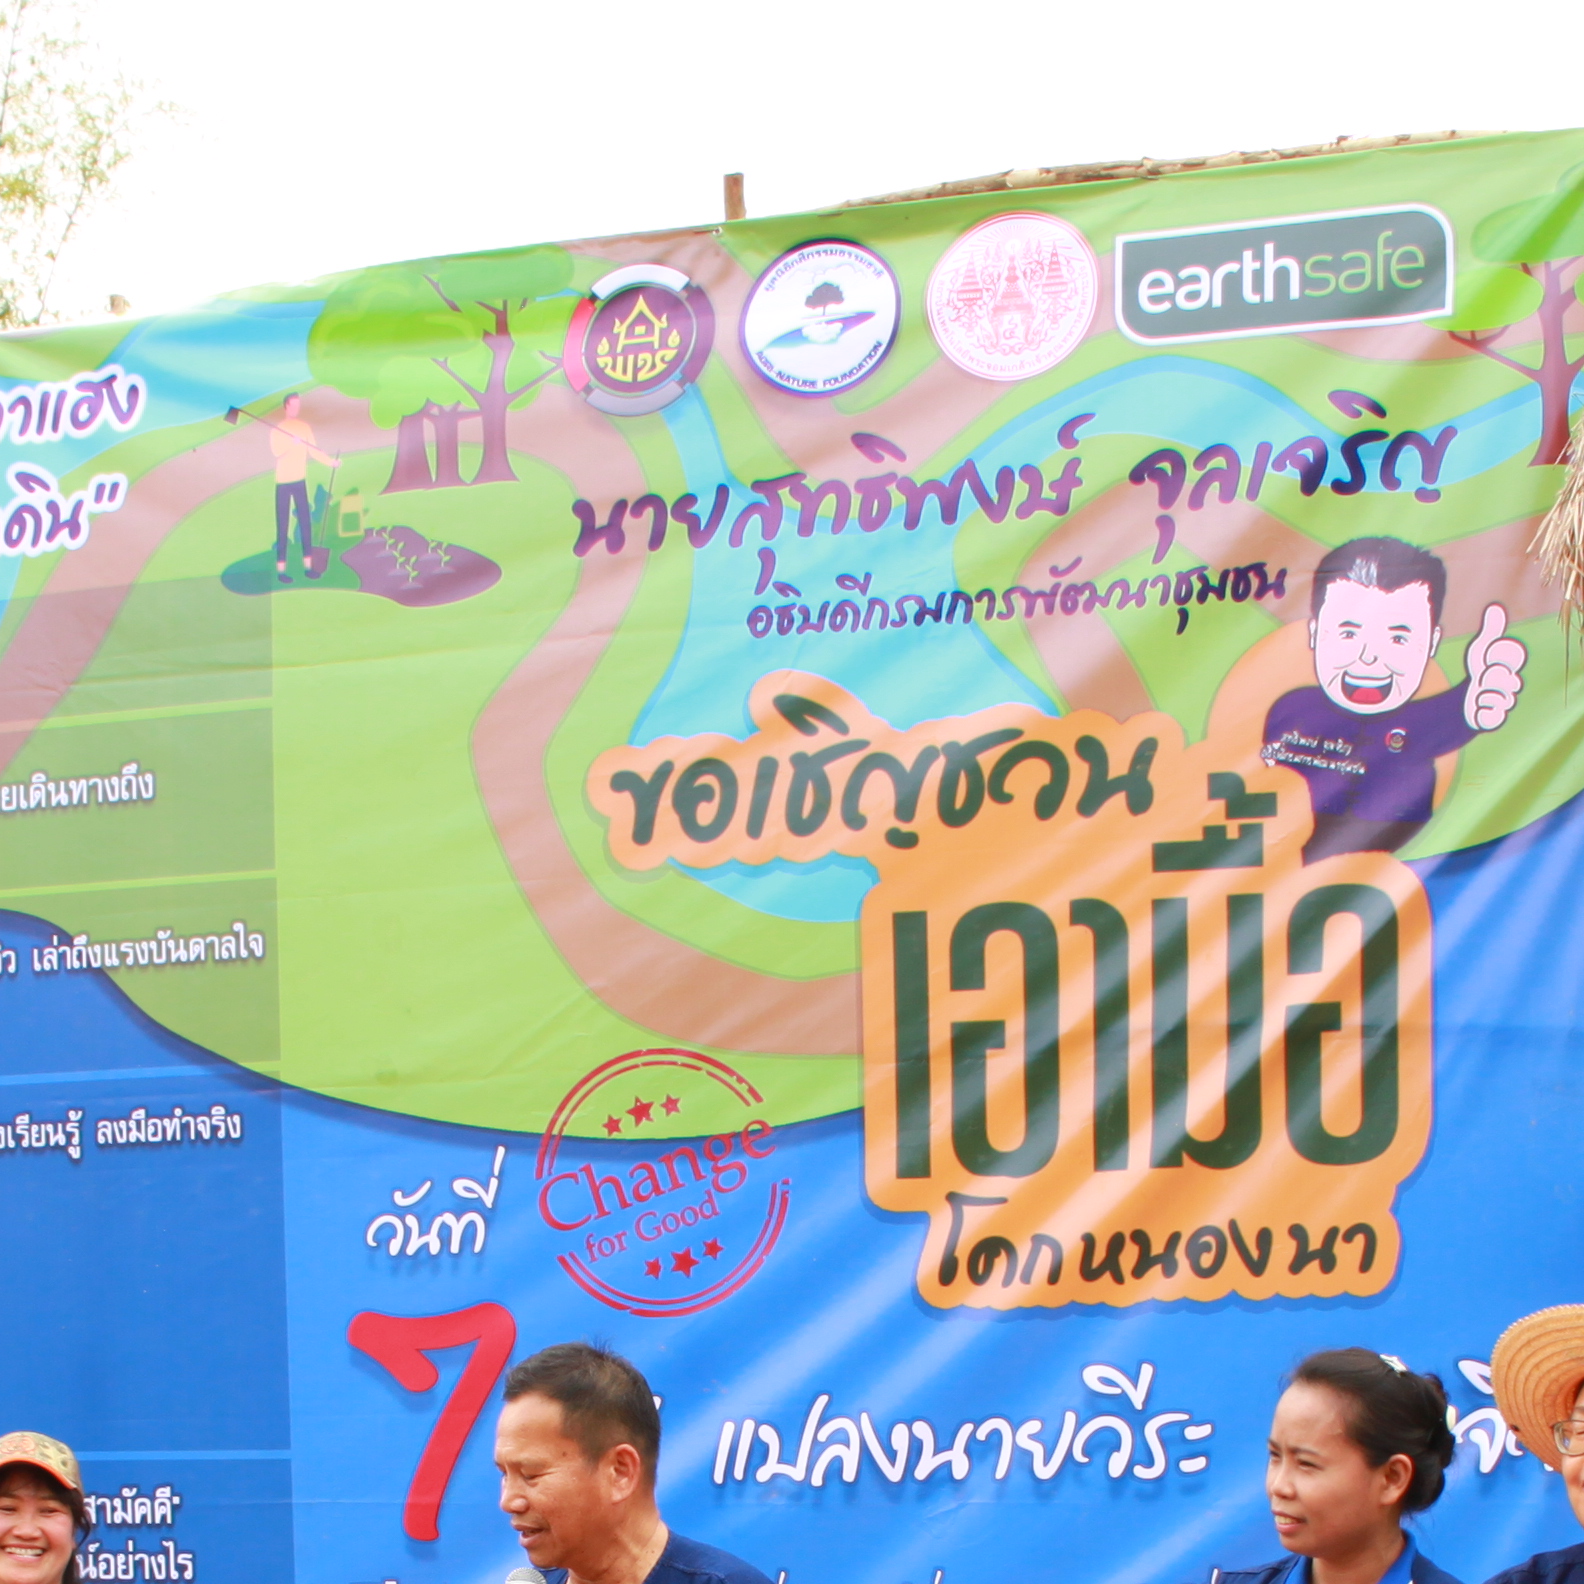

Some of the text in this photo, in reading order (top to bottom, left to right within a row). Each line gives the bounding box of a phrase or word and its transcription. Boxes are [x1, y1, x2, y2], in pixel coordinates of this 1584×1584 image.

[1137, 236, 1427, 315] earthsafe
[822, 340, 883, 388] FOUNDATION
[572, 389, 1458, 595] นายสุทธิพงษ์ จุลเจริญ
[747, 556, 1287, 638] อธิบดีกรมการพัฒนาชุมชน
[609, 694, 1159, 848] ขอเชิญชวน
[33, 922, 265, 974] เล่าถึงแรงบันดาลใจ
[891, 771, 1399, 1179] เอามื้อ
[96, 1106, 241, 1146] ลงมือทำจริง
[538, 1119, 777, 1232] Change
[365, 1144, 506, 1258] วันที่
[585, 1189, 721, 1263] for Good
[347, 1302, 517, 1541] 7
[713, 1361, 1214, 1487] แปลงนายวีระ
